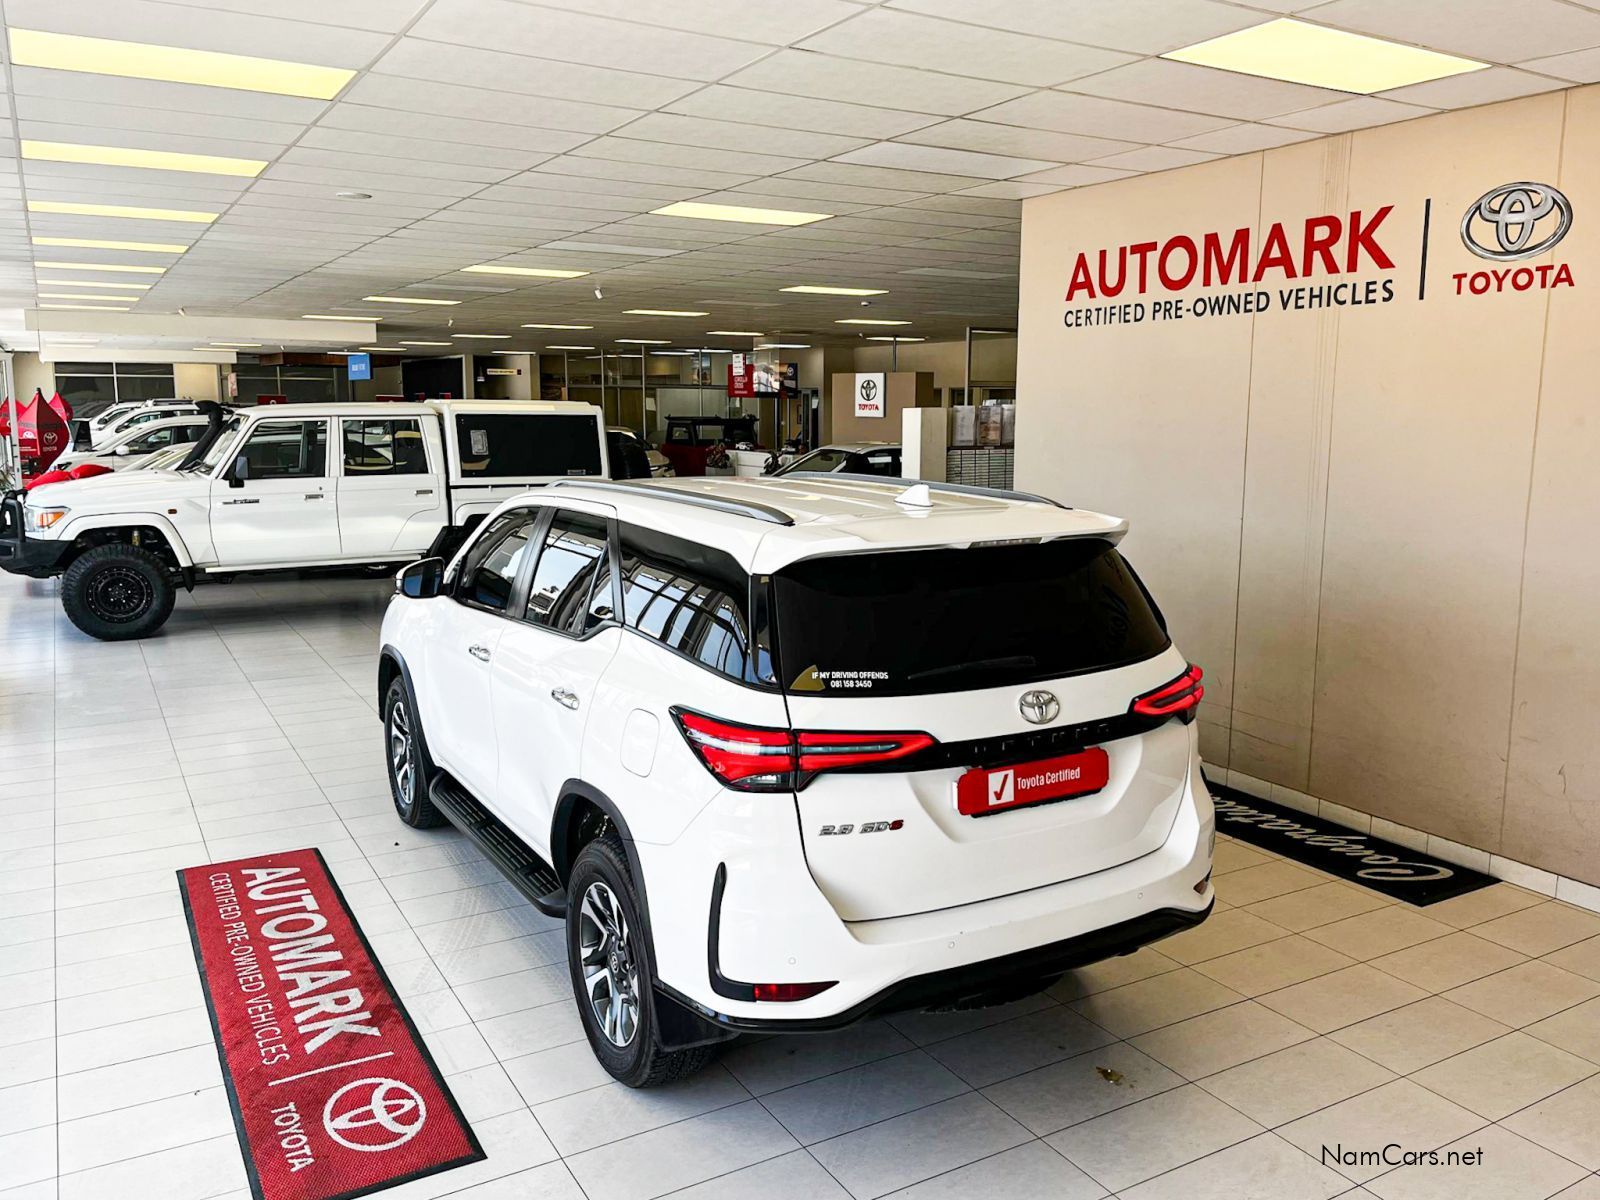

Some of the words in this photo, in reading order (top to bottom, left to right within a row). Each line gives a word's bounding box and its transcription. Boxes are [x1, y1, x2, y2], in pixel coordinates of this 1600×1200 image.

[1065, 205, 1396, 301] AUTOMARK
[1064, 303, 1146, 328] CERTIFIED
[1152, 291, 1271, 321] PRE-OWNED
[1279, 279, 1394, 311] VEHICLES
[1452, 263, 1575, 295] TOYOTA
[811, 671, 819, 679] IF
[819, 671, 831, 679] MY
[831, 671, 858, 679] DRIVING
[859, 671, 889, 679] OFFENDS
[830, 680, 842, 688] 081
[855, 680, 872, 688] 3450
[1017, 773, 1045, 790] Toyota
[1045, 766, 1081, 784] Certified
[209, 872, 242, 920] CERTIFIED
[223, 921, 266, 993] PRE-OWNED
[241, 867, 382, 1055] AUTOMARK
[245, 993, 291, 1065] VEHICLES
[270, 1102, 315, 1172] TOYOTA
